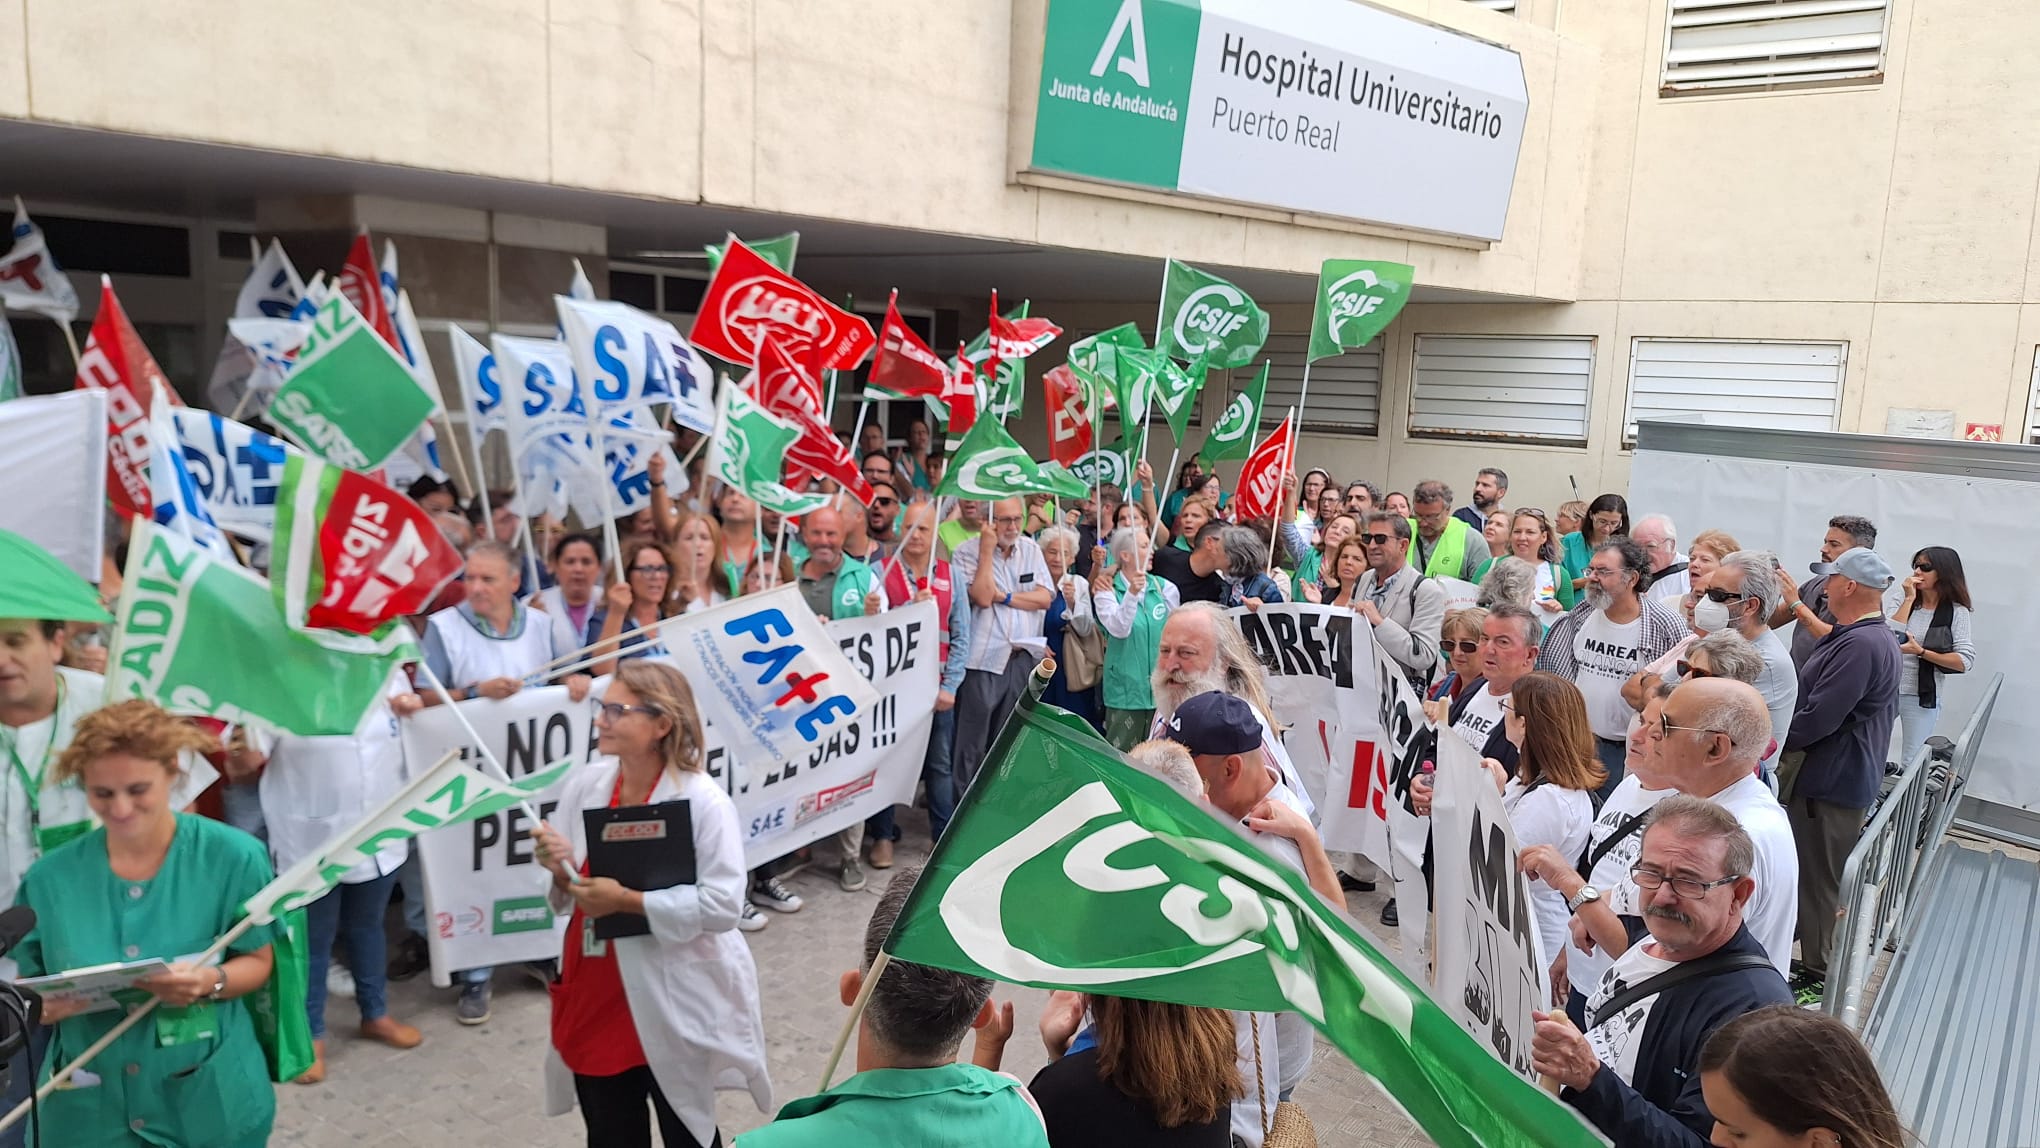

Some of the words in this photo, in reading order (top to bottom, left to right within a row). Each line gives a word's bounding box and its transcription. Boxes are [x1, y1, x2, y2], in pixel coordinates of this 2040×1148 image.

[1048, 78, 1091, 103] Junta
[1092, 86, 1111, 108] de
[1112, 91, 1178, 122] Andalucía
[1219, 32, 1343, 101] Hospital
[1349, 67, 1502, 140] Universitario
[1211, 98, 1289, 143] Puerto
[1294, 115, 1340, 153] Real
[1186, 302, 1250, 339] CSIF
[1250, 447, 1286, 508] UG
[885, 621, 922, 678] DE
[1231, 611, 1354, 689] AREA
[1585, 638, 1638, 661] MAREA
[506, 712, 572, 780] NO
